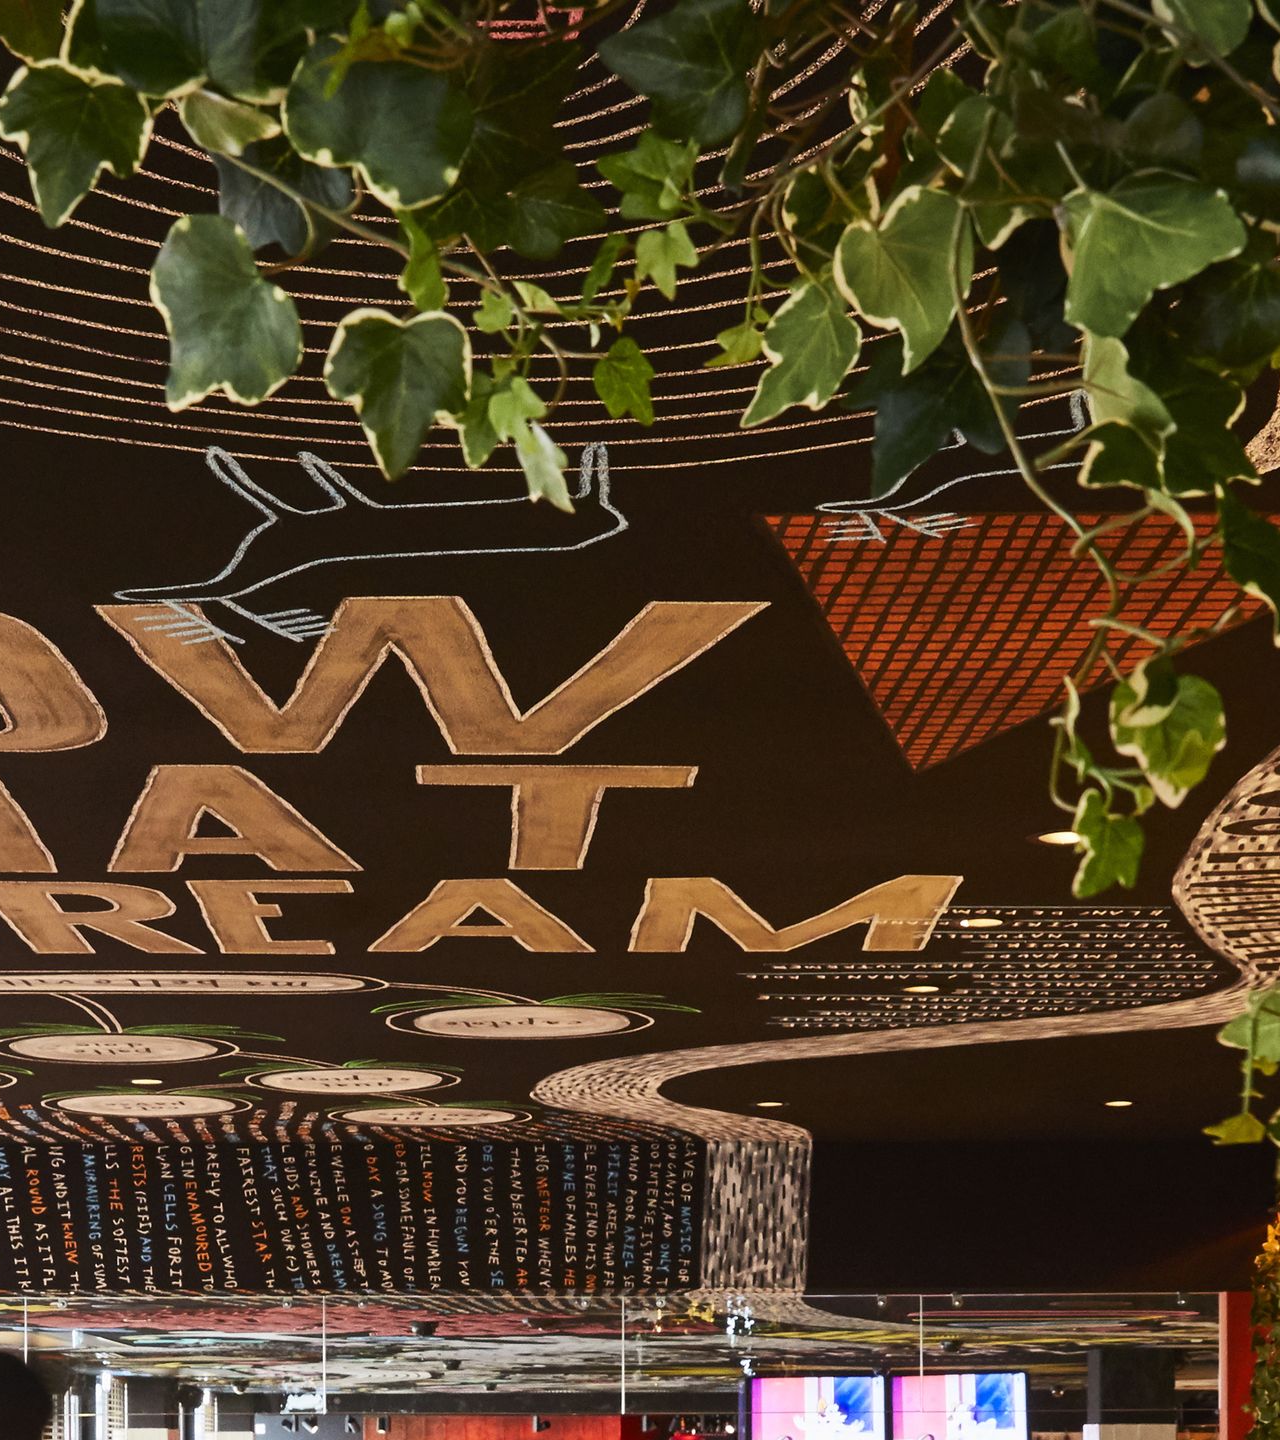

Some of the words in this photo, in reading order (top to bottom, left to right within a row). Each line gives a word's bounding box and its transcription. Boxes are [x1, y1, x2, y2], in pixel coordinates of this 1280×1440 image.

[95, 979, 219, 988] belle
[446, 1018, 582, 1028] capitole
[181, 1159, 194, 1178] IN
[367, 1157, 380, 1181] DAY
[396, 1162, 409, 1183] FOR
[455, 1146, 468, 1172] AND
[510, 1148, 522, 1189] THAN
[564, 1145, 575, 1189] HRONE
[608, 1147, 619, 1196] SPIRIT
[52, 1173, 67, 1198] AND
[205, 1152, 220, 1197] REPLY
[284, 1157, 299, 1190] BUDS
[423, 1172, 432, 1202] NOW
[585, 1165, 596, 1198] EVER
[27, 1169, 47, 1214] ROUND
[109, 1179, 123, 1210] THE
[262, 1147, 277, 1181] THAT
[271, 1188, 288, 1221] SUCH
[281, 1229, 295, 1251] OUR
[331, 1156, 349, 1201] WHILE
[341, 1207, 351, 1225] ON
[456, 1179, 466, 1204] YOU
[483, 1179, 493, 1200] YOU
[566, 1196, 575, 1210] OF
[681, 1184, 692, 1201] OF
[57, 1201, 71, 1219] IT
[83, 1155, 101, 1239] MURMURING
[92, 1245, 103, 1259] OF
[164, 1184, 177, 1230] CELLS
[213, 1202, 223, 1223] TO
[237, 1148, 260, 1215] FAIREST
[252, 1222, 272, 1262] STAR
[291, 1197, 308, 1218] AND
[399, 1188, 413, 1222] SOME
[424, 1208, 437, 1224] IN
[537, 1177, 550, 1231] METEOR
[625, 1189, 636, 1220] POOR
[6, 1216, 23, 1249] THIS
[34, 1223, 48, 1240] AS
[185, 1181, 213, 1272] ENAMOURED
[319, 1212, 335, 1239] AND
[373, 1205, 386, 1240] SONG
[455, 1209, 468, 1252] BEGUN
[510, 1194, 527, 1262] DESERTED
[586, 1202, 598, 1237] FIND
[606, 1203, 616, 1238] ARIEL
[663, 1213, 673, 1237] AND
[62, 1223, 79, 1264] KNEW
[113, 1218, 130, 1283] SOFTEST
[140, 1237, 151, 1262] AND
[168, 1237, 182, 1266] FOR
[215, 1229, 230, 1253] ALL
[401, 1226, 415, 1261] FAULT
[488, 1240, 499, 1264] THE
[623, 1227, 635, 1267] ARIEL
[640, 1233, 653, 1246] IS
[14, 1257, 28, 1276] IT
[38, 1246, 53, 1263] IT
[296, 1223, 322, 1286] SHOWERS
[377, 1248, 388, 1266] TO
[538, 1238, 552, 1276] WHEN
[585, 1243, 596, 1269] HIS
[603, 1243, 614, 1266] WHO
[657, 1245, 669, 1271] ONLY
[143, 1266, 157, 1293] THE
[171, 1269, 182, 1287] IT
[223, 1255, 238, 1290] WHO
[404, 1268, 414, 1281] OF
[491, 1271, 503, 1286] SE
[678, 1259, 690, 1282] FOR
